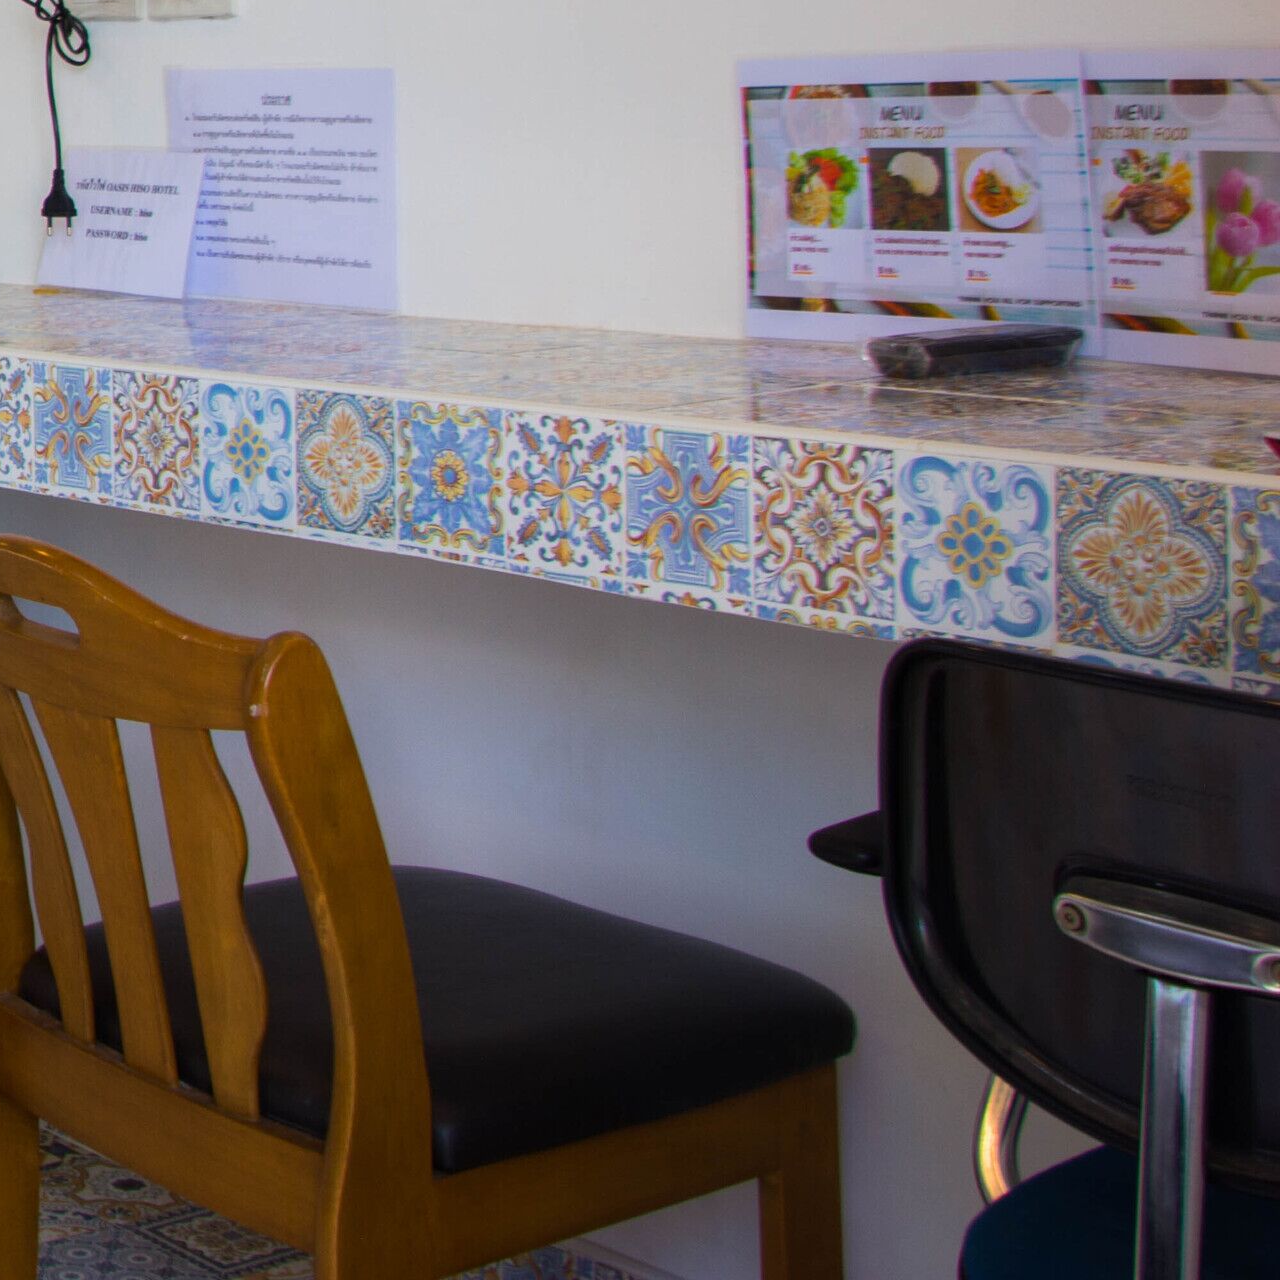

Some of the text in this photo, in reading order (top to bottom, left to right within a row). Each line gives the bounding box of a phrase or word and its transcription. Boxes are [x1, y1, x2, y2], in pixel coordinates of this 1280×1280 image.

[880, 105, 924, 121] MENU
[1113, 104, 1164, 121] MENU
[106, 183, 129, 193] OASIS
[151, 184, 180, 195] HOTEL
[91, 206, 132, 216] USERNAME
[86, 229, 128, 240] PASSWORD
